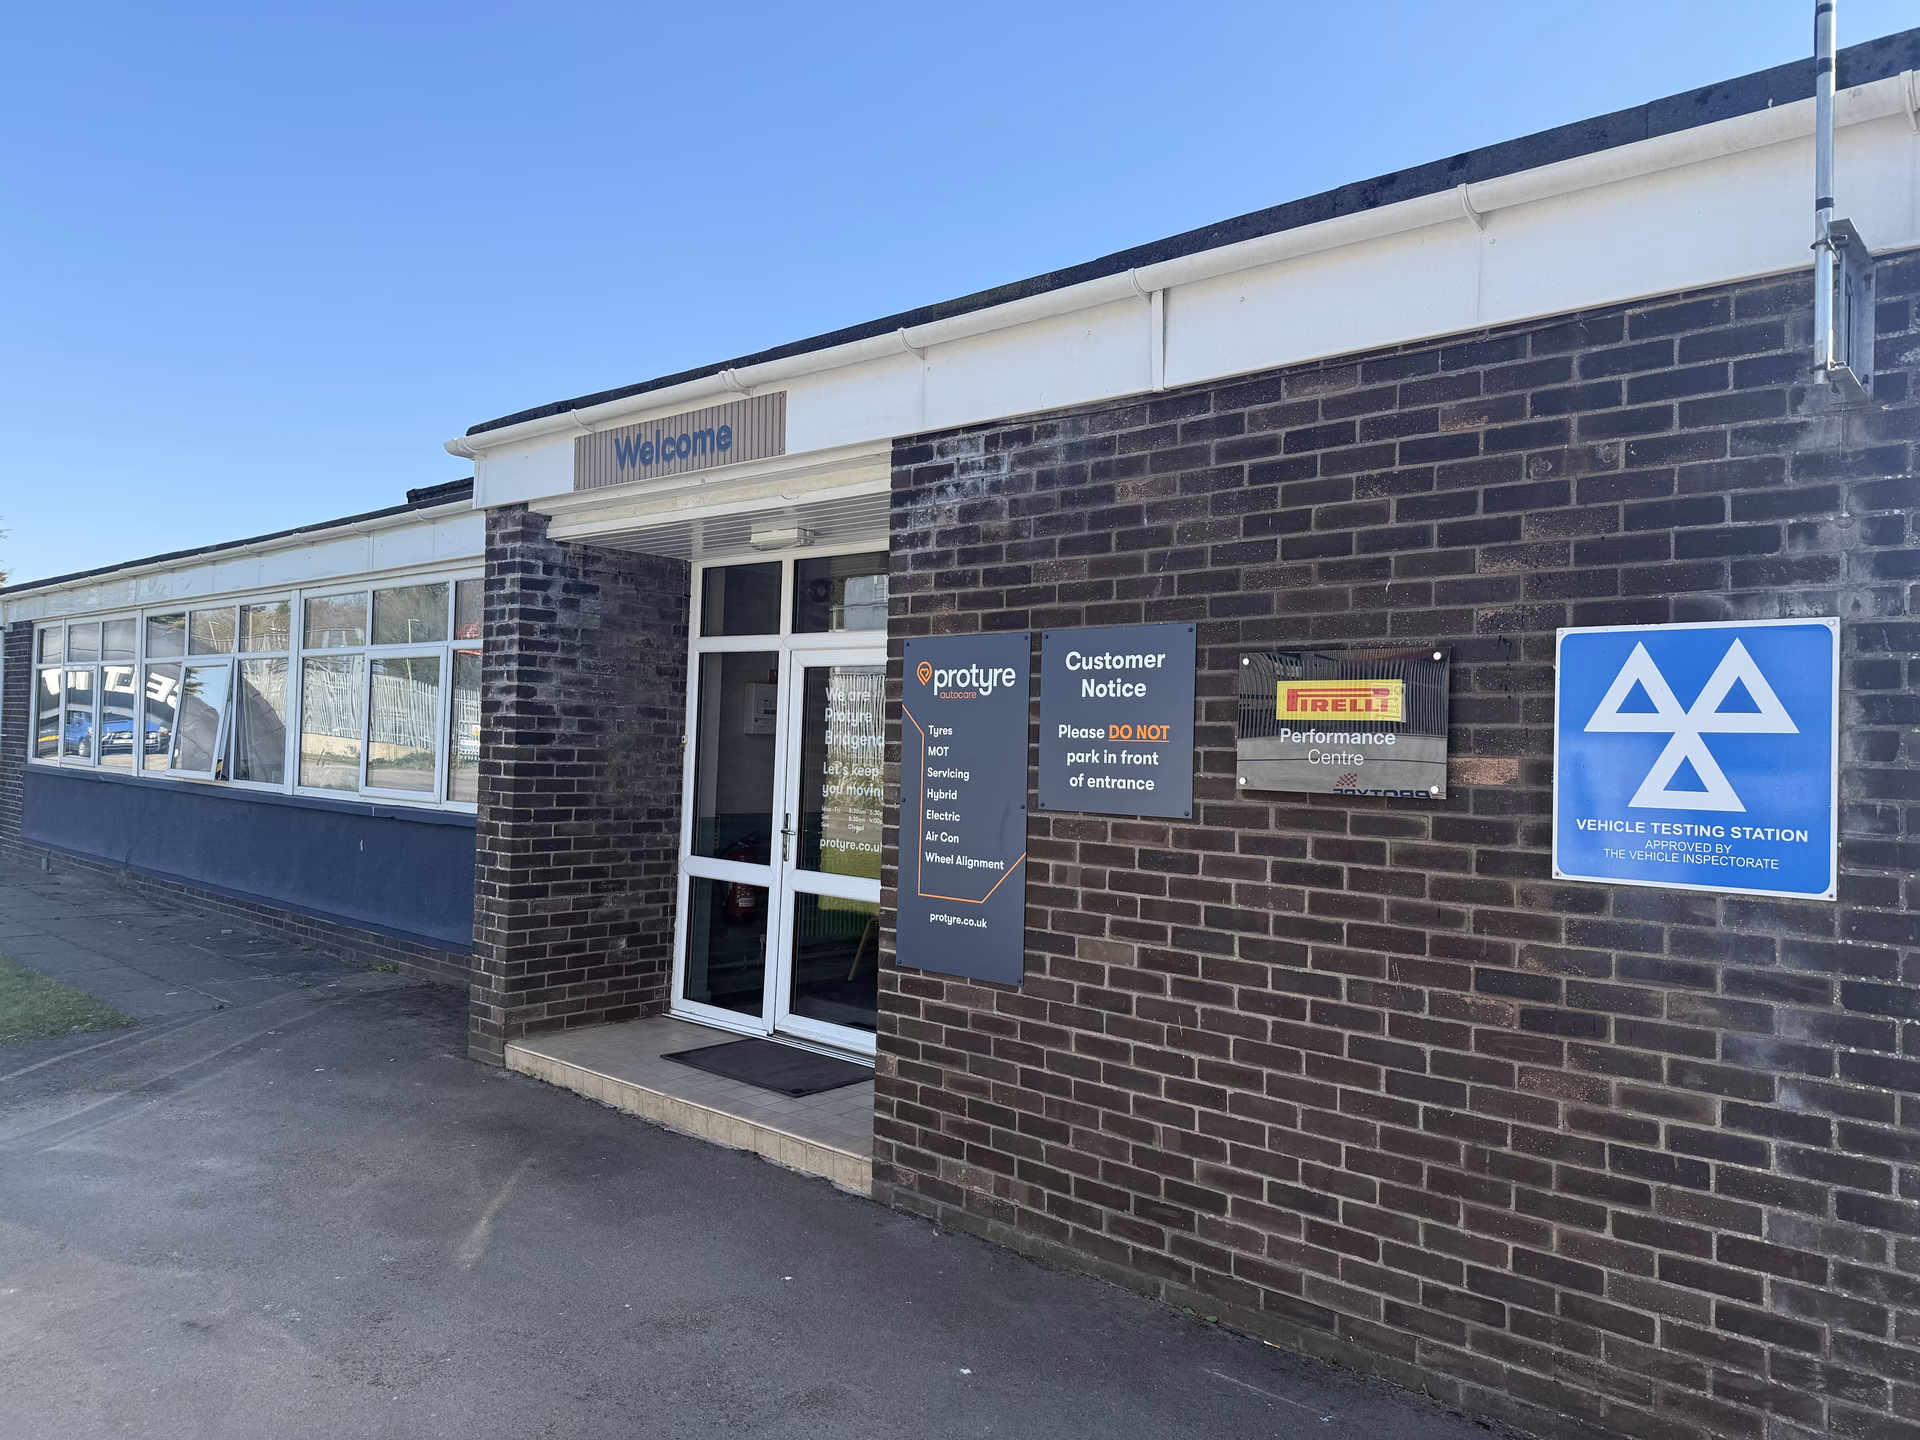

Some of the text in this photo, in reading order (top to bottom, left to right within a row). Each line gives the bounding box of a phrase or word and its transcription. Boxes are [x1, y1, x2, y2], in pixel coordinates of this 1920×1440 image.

[614, 424, 732, 471] Welcome
[1065, 651, 1166, 671] Customer
[934, 663, 1016, 696] protyre
[825, 687, 870, 702] We are
[940, 690, 977, 700] autocare
[1081, 679, 1147, 698] Notice
[1286, 688, 1391, 713] PIRELLI
[824, 707, 872, 727] Protyre
[824, 730, 884, 749] Bridgend
[928, 725, 953, 737] Tyres
[1058, 725, 1170, 740] Please DO NOT
[1280, 728, 1396, 745] Performance
[928, 746, 949, 757] MOT
[1067, 750, 1159, 766] park in front
[1308, 749, 1364, 766] Centre
[823, 761, 880, 781] Let's keep
[927, 768, 970, 781] Servicing
[1070, 774, 1155, 791] of entrance
[822, 785, 843, 798] you
[927, 788, 957, 801] Hybrid
[926, 810, 961, 822] Electric
[925, 831, 960, 844] Air Con
[1575, 818, 1809, 843] VEHICLE TESTING STATION
[1645, 840, 1733, 855] APPROVED BY
[925, 851, 1005, 871] Wheel Alignment
[1604, 848, 1780, 870] THE VEHICLE INSPECTORATE
[930, 912, 988, 929] protyre.co.uk
